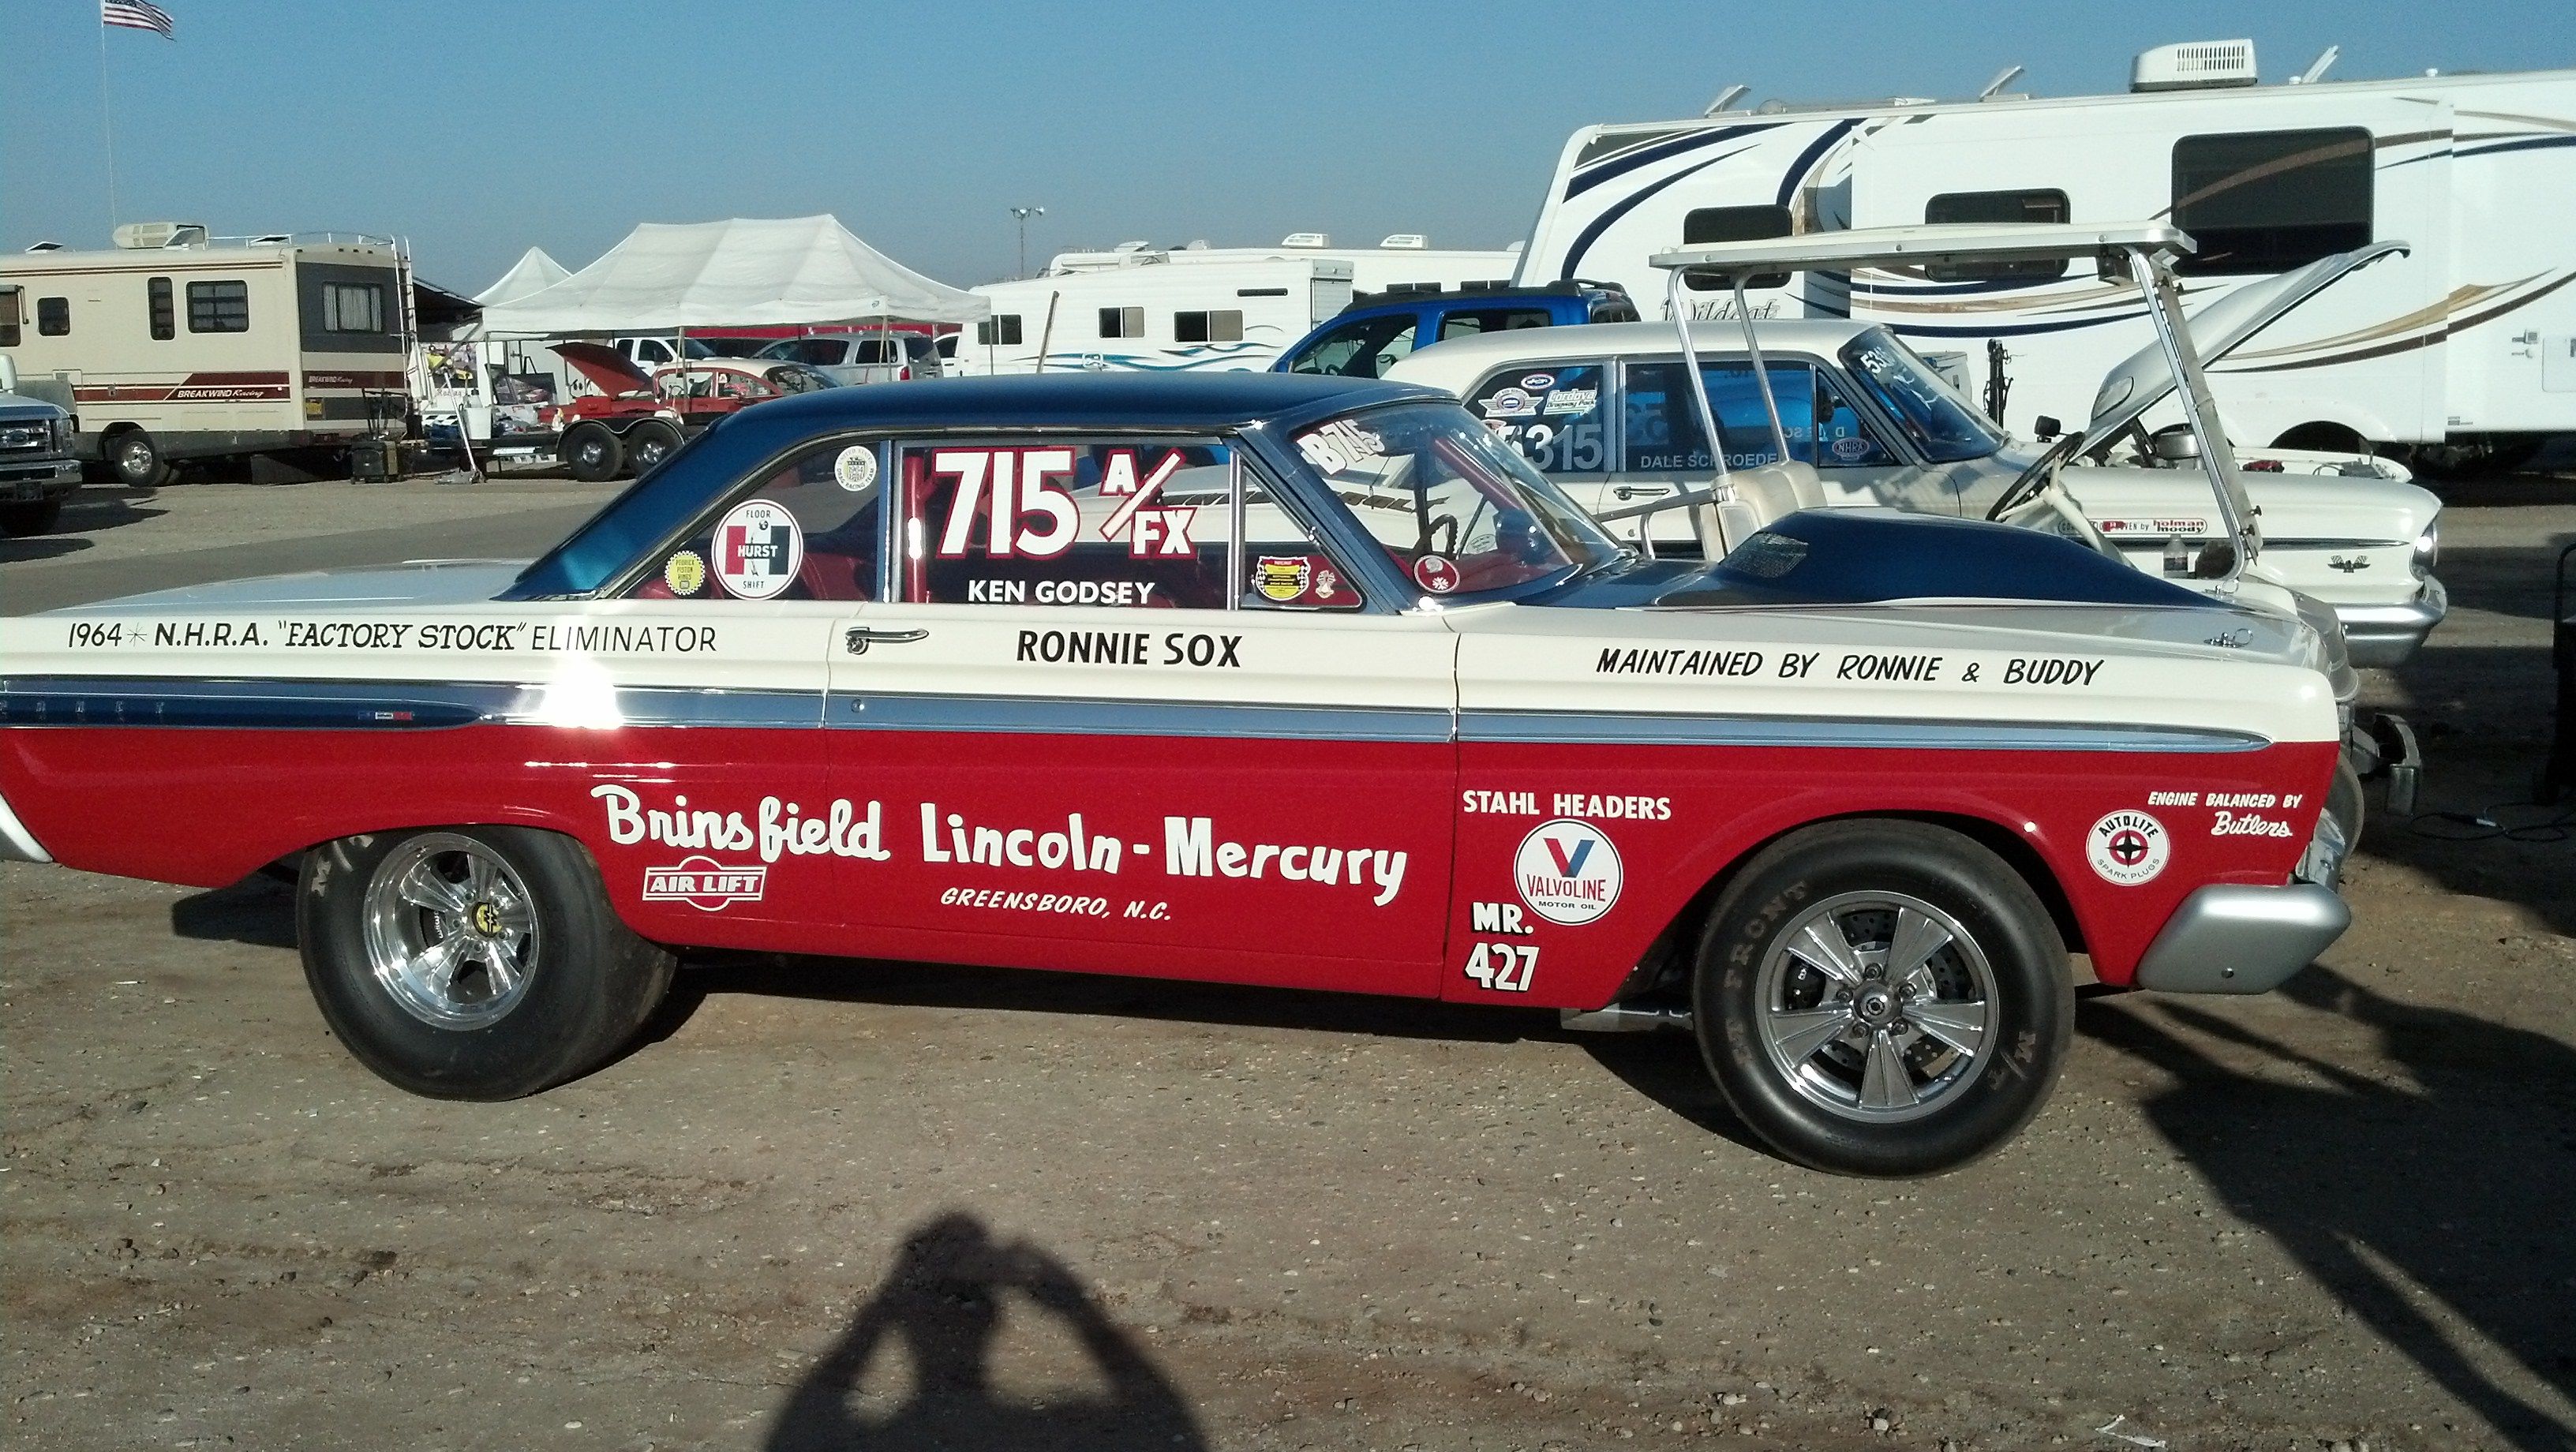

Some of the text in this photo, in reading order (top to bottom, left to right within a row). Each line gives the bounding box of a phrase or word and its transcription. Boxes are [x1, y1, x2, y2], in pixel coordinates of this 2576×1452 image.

[178, 389, 264, 398] BREAKWIND Racing
[1548, 388, 1597, 402] Cordova
[1837, 441, 1863, 453] NHRA
[1641, 453, 1779, 468] DALE SCROEDE
[746, 510, 771, 519] FLOOR
[933, 448, 1080, 557] 715
[737, 544, 778, 558] HURST
[743, 580, 765, 589] SHIFT
[968, 580, 1155, 604] KEN GODSEY
[68, 623, 123, 647] 1964
[153, 623, 270, 647] N.H.R.A.
[531, 626, 718, 652] ELIMINATOR
[1017, 631, 1243, 667] RONNIE SOX
[1597, 648, 2104, 686] MAINTAINED BY RONNIE & BUDDY
[1462, 790, 1672, 820] STAHL HEADERS
[2147, 791, 2303, 808] ENGINE BALANCED BY
[590, 784, 890, 863] Brinsfield
[2099, 815, 2159, 838] AUTOLITE
[2211, 811, 2293, 837] Butlers
[2097, 857, 2160, 880] SPARK PLUGS
[650, 874, 759, 894] AIR LIFT
[1526, 874, 1606, 902] VALVOLINE
[941, 887, 1171, 921] GREENSBORO, N.C.
[1472, 902, 1534, 934] MR.
[1465, 942, 1540, 991] 427
